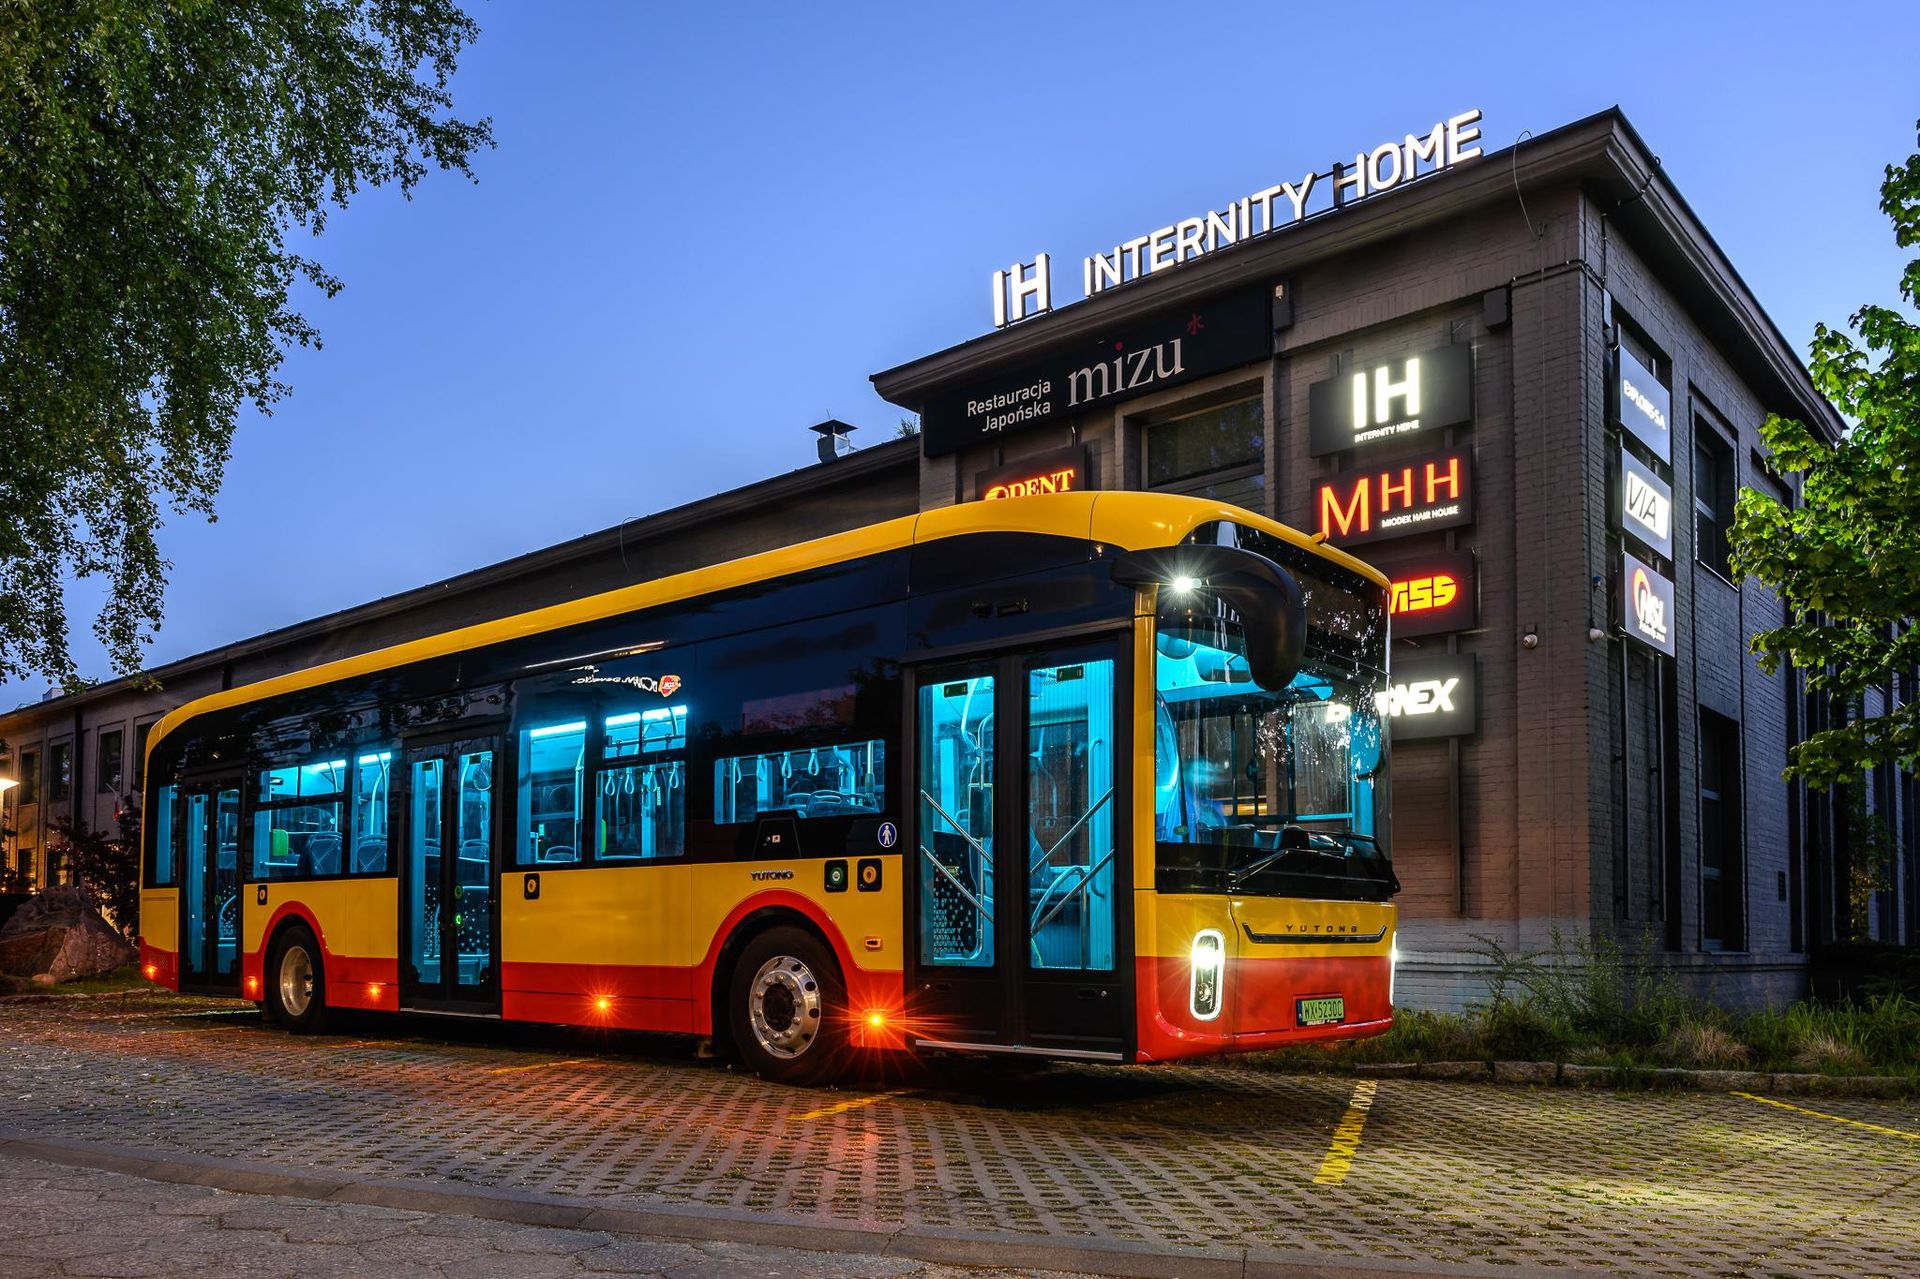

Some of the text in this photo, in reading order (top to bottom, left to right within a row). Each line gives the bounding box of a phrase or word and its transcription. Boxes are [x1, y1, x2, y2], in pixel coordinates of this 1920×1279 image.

[1084, 108, 1483, 298] INTERNITY HOME
[993, 253, 1051, 328] IH
[1067, 338, 1185, 407] mizu
[967, 378, 1051, 418] Restauracja
[1353, 357, 1421, 430] IH
[982, 401, 1051, 432] Japońska
[1354, 419, 1420, 443] INTERNITY HOME
[1412, 510, 1432, 522] HAIR
[1431, 505, 1459, 519] HOUSE
[1628, 476, 1657, 528] VIA
[750, 869, 795, 882] YUTONG
[1285, 923, 1358, 933] YUTONG
